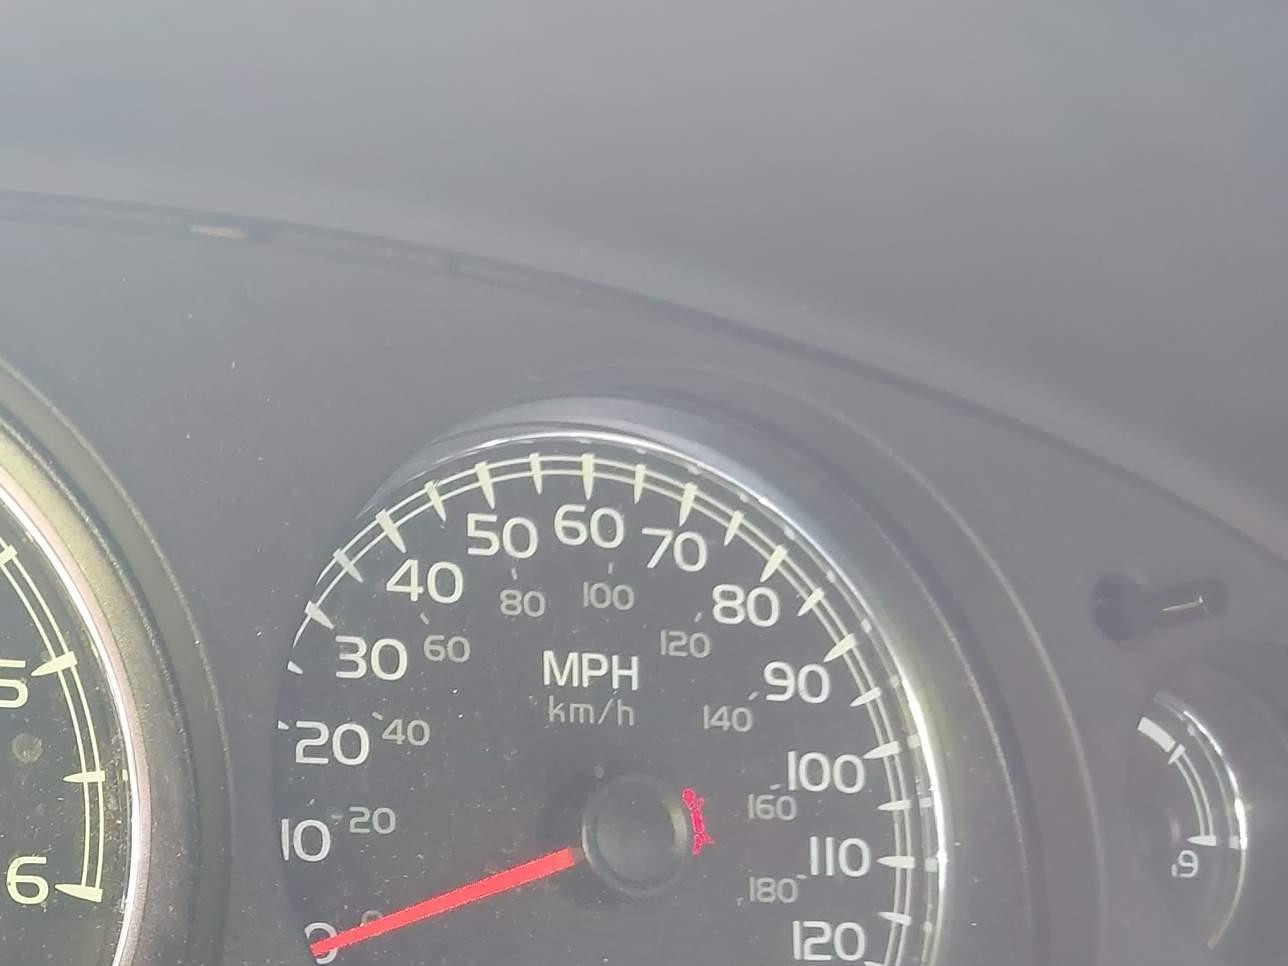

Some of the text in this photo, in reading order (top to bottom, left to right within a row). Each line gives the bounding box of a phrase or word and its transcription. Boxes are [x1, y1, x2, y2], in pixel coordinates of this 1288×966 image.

[466, 512, 538, 558] 50
[553, 503, 625, 549] 60
[641, 527, 708, 572] 70
[385, 559, 464, 604] 40
[582, 582, 635, 611] 100
[499, 588, 546, 618] 80
[711, 583, 781, 628] 80
[334, 635, 408, 681] 30
[423, 634, 471, 663] 60
[660, 629, 711, 659] 120
[542, 650, 640, 692] MPH
[762, 660, 831, 704] 90
[381, 718, 431, 746] 40
[548, 695, 635, 727] km/h
[702, 704, 753, 733] 140
[294, 719, 371, 766] 20
[786, 749, 865, 794] 100
[348, 805, 397, 835] 20
[746, 792, 797, 821] 160
[280, 817, 331, 862] 10
[808, 835, 872, 877] 110
[5, 856, 49, 904] 6
[748, 876, 799, 904] 180
[791, 919, 865, 961] 120
